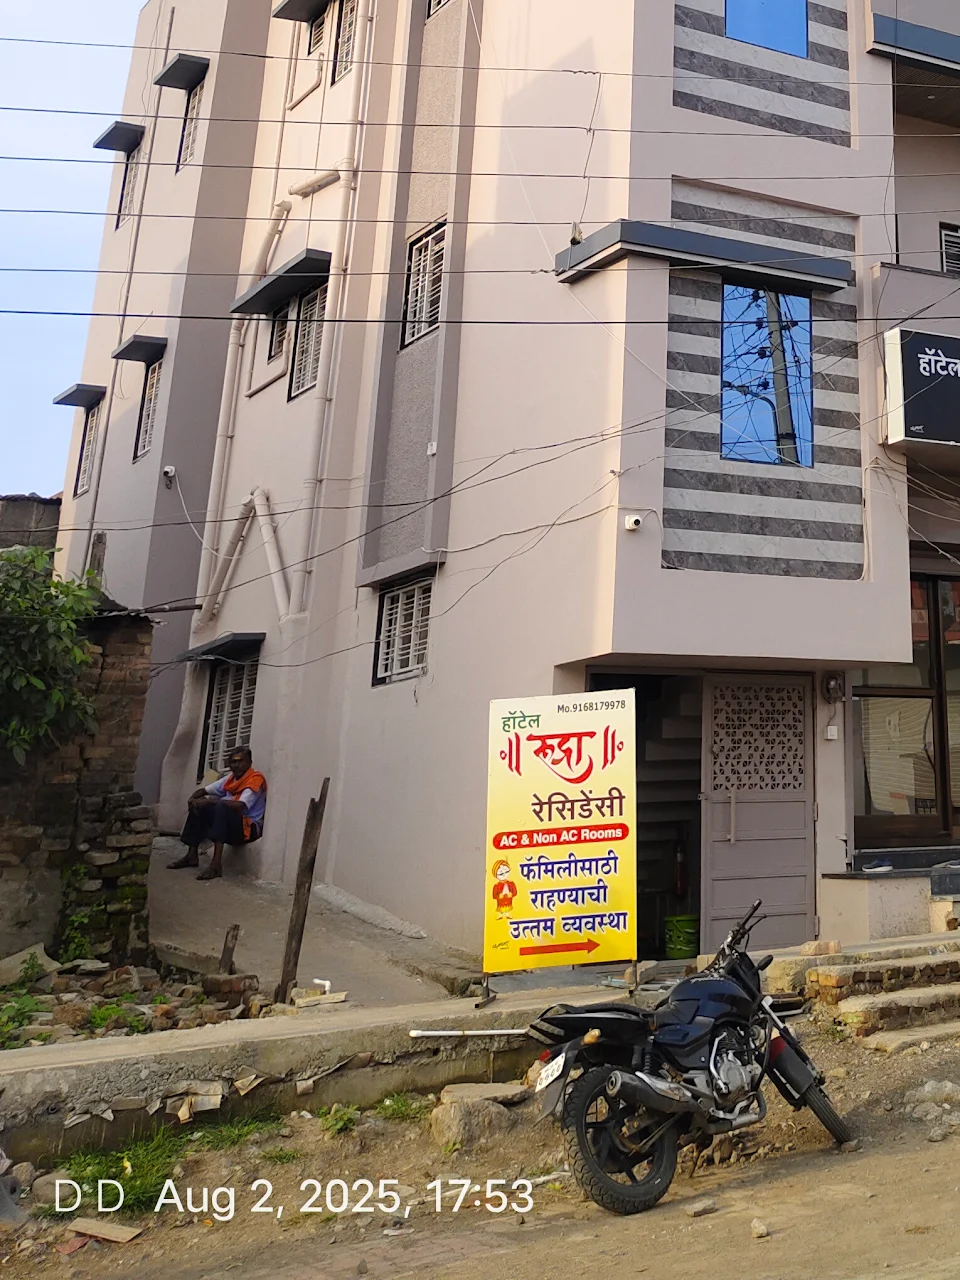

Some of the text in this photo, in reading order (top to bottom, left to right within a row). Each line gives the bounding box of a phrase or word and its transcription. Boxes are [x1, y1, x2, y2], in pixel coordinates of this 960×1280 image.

[557, 700, 626, 714] Mo.9168179978
[501, 711, 541, 733] हॉटेल
[531, 786, 626, 823] रेसिडेंसी
[500, 828, 623, 847] AC & Non AC Rooms
[519, 849, 619, 881] फॅमिलीसाठी
[530, 878, 608, 912] राहण्याची
[509, 912, 628, 939] उत्तम व्यवस्था
